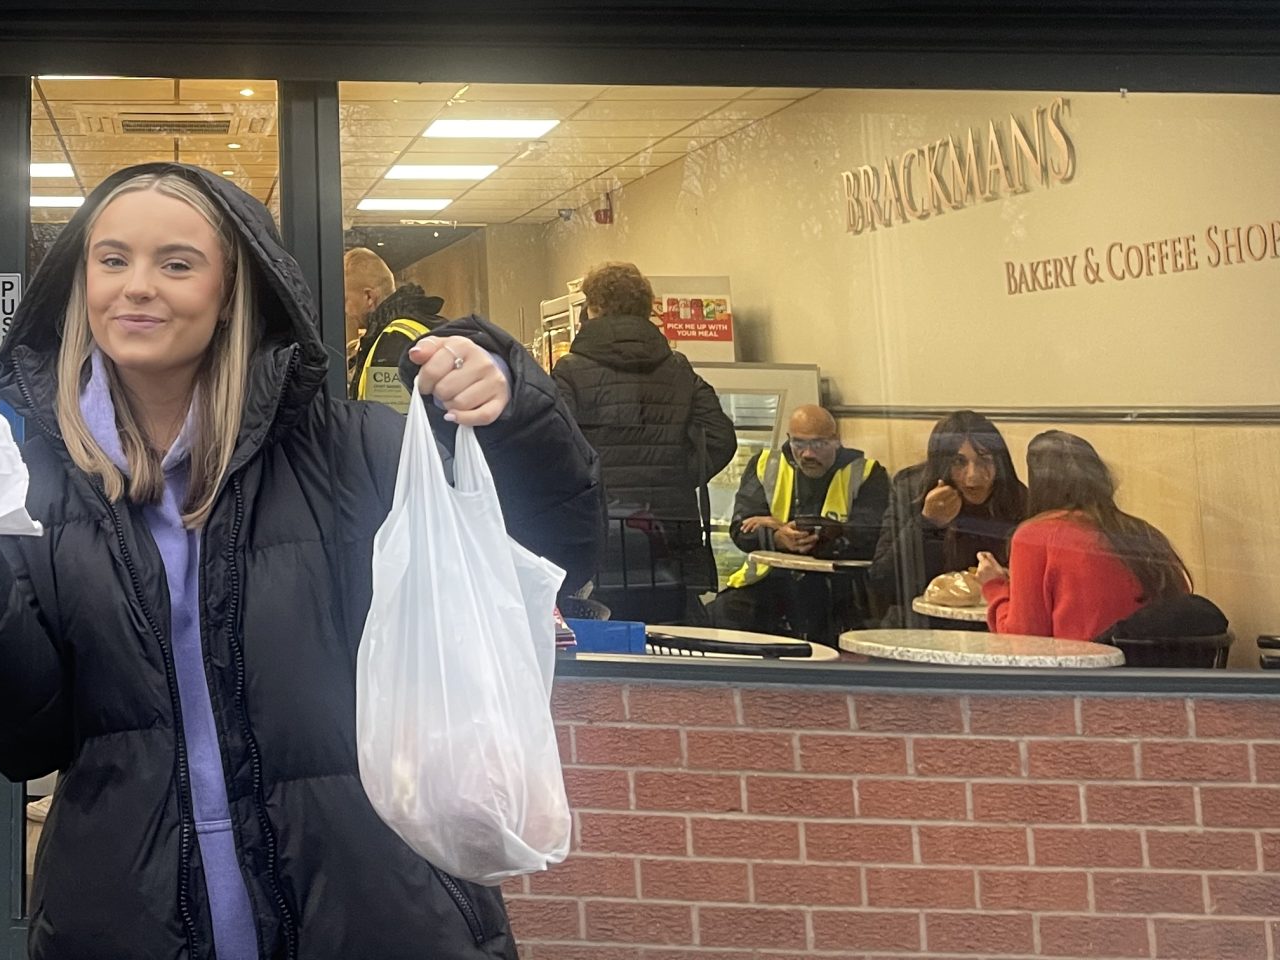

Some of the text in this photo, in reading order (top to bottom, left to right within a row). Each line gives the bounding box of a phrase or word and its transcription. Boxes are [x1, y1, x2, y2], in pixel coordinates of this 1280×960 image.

[841, 96, 1075, 235] BRACKMANS
[1005, 255, 1077, 295] BAKERY
[1083, 246, 1104, 285] &
[1106, 234, 1198, 281] COFFEE
